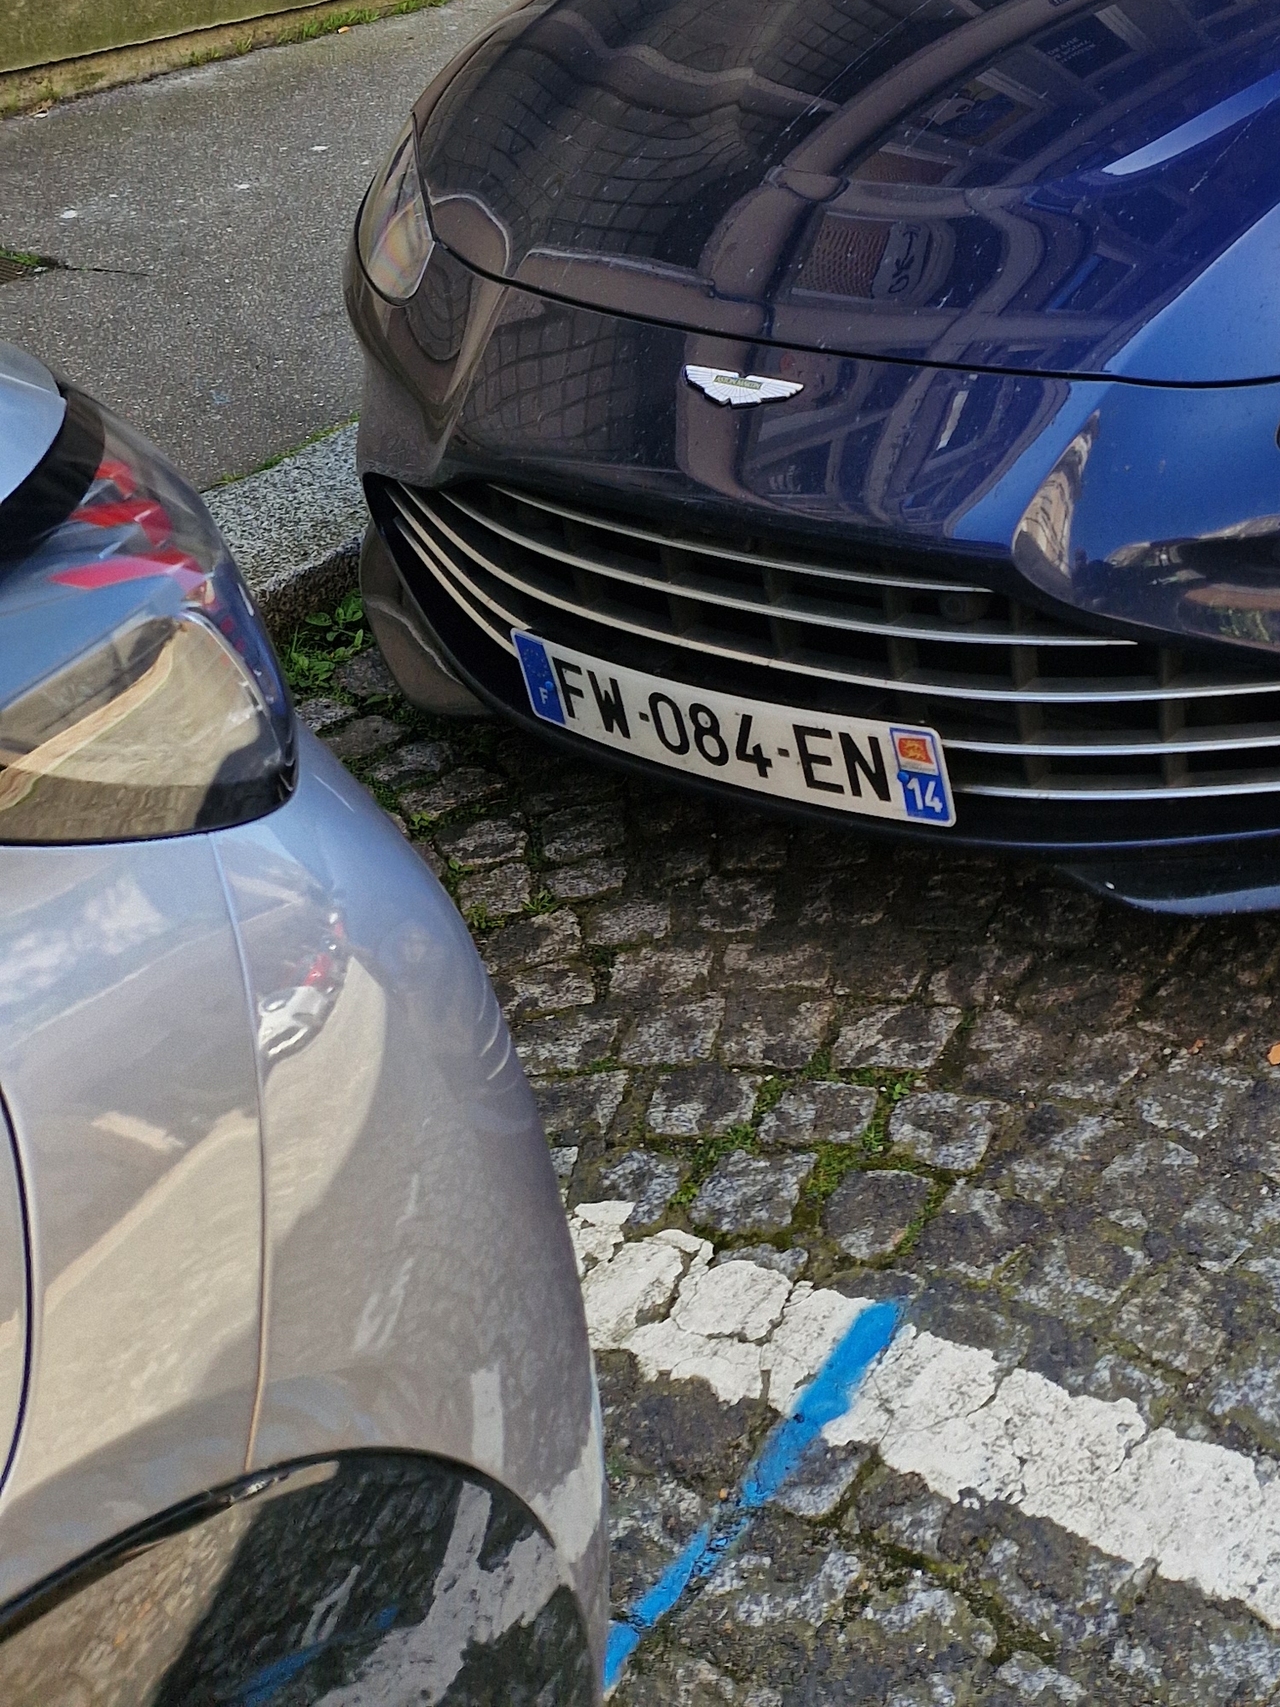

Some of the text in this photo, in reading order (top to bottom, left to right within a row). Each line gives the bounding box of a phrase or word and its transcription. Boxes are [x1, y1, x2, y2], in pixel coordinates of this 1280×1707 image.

[538, 686, 549, 705] F
[552, 657, 892, 802] FW-084-EN
[906, 777, 943, 813] 14
